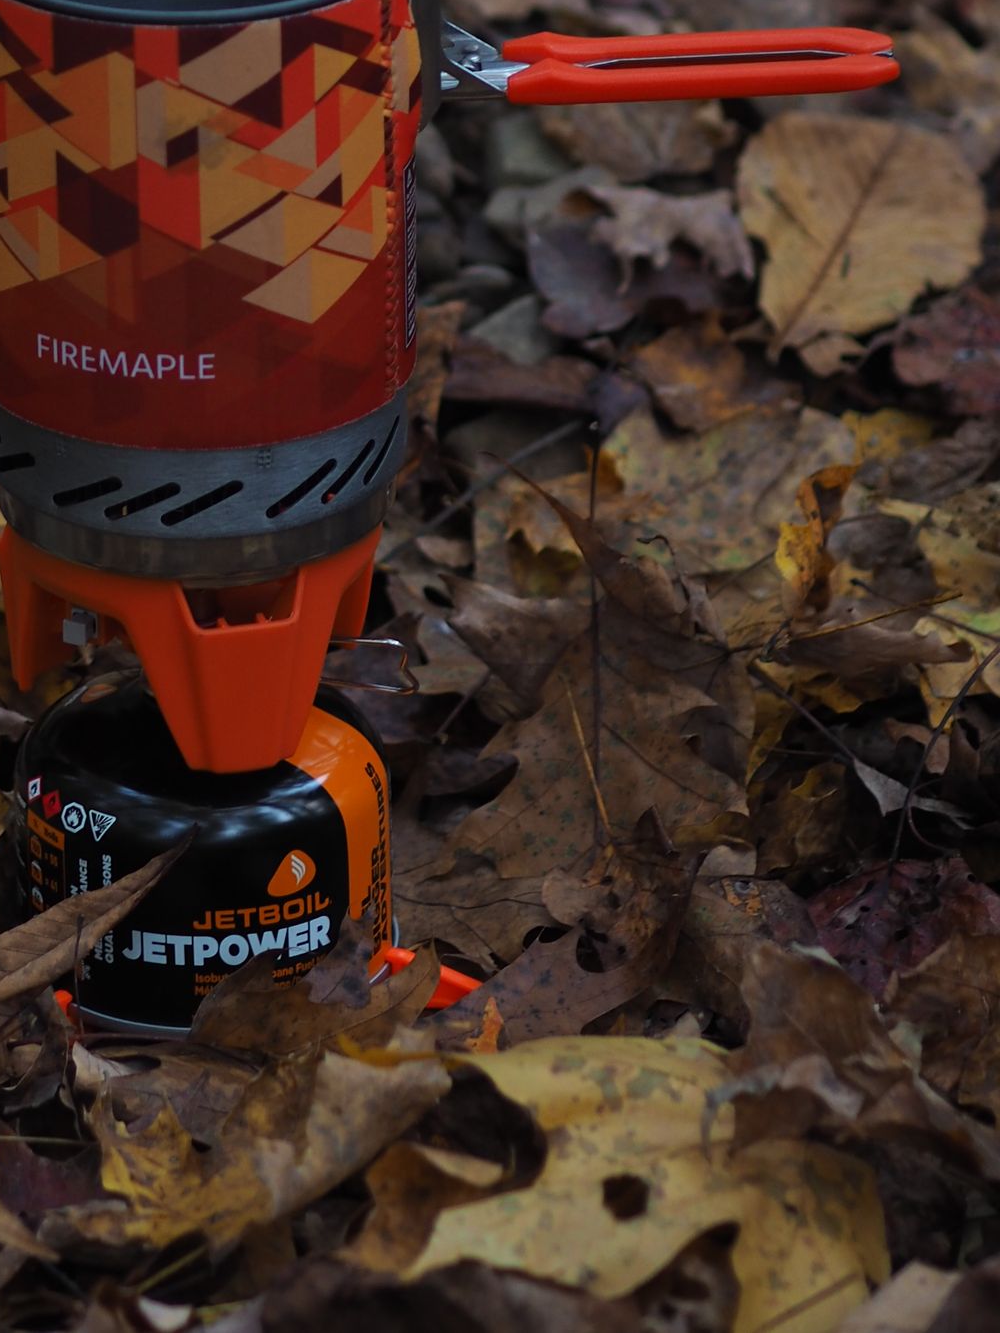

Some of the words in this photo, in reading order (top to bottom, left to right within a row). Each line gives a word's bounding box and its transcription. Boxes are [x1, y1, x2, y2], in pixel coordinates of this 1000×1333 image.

[36, 332, 216, 381] FIREMAPLE
[364, 761, 388, 941] ADVENTURES
[192, 891, 331, 931] JETBOIL
[121, 914, 332, 967] JETPOWER
